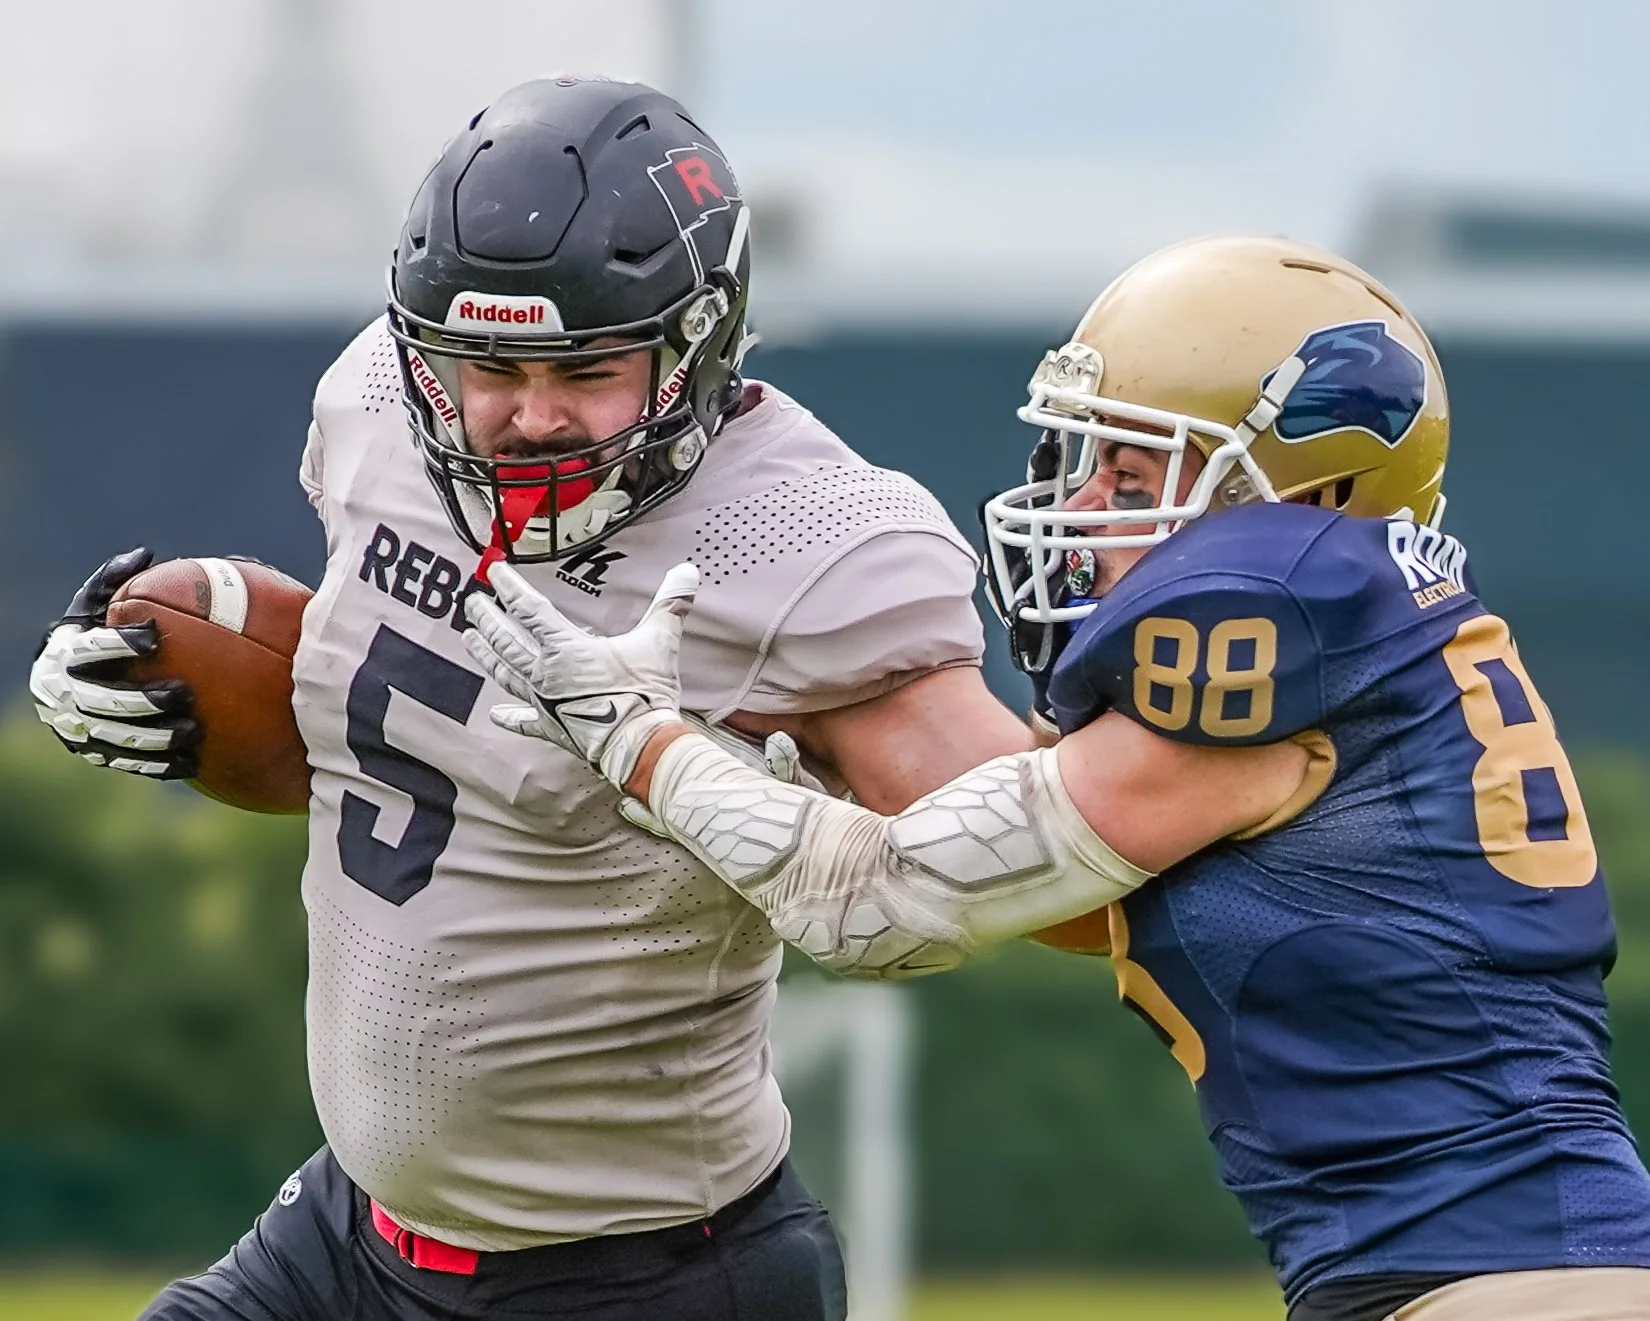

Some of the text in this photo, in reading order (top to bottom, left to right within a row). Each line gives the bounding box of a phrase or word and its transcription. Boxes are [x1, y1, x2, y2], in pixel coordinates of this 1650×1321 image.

[674, 156, 724, 206] R
[460, 300, 545, 325] Riddell
[1133, 616, 1277, 738] 88
[336, 622, 486, 907] 5
